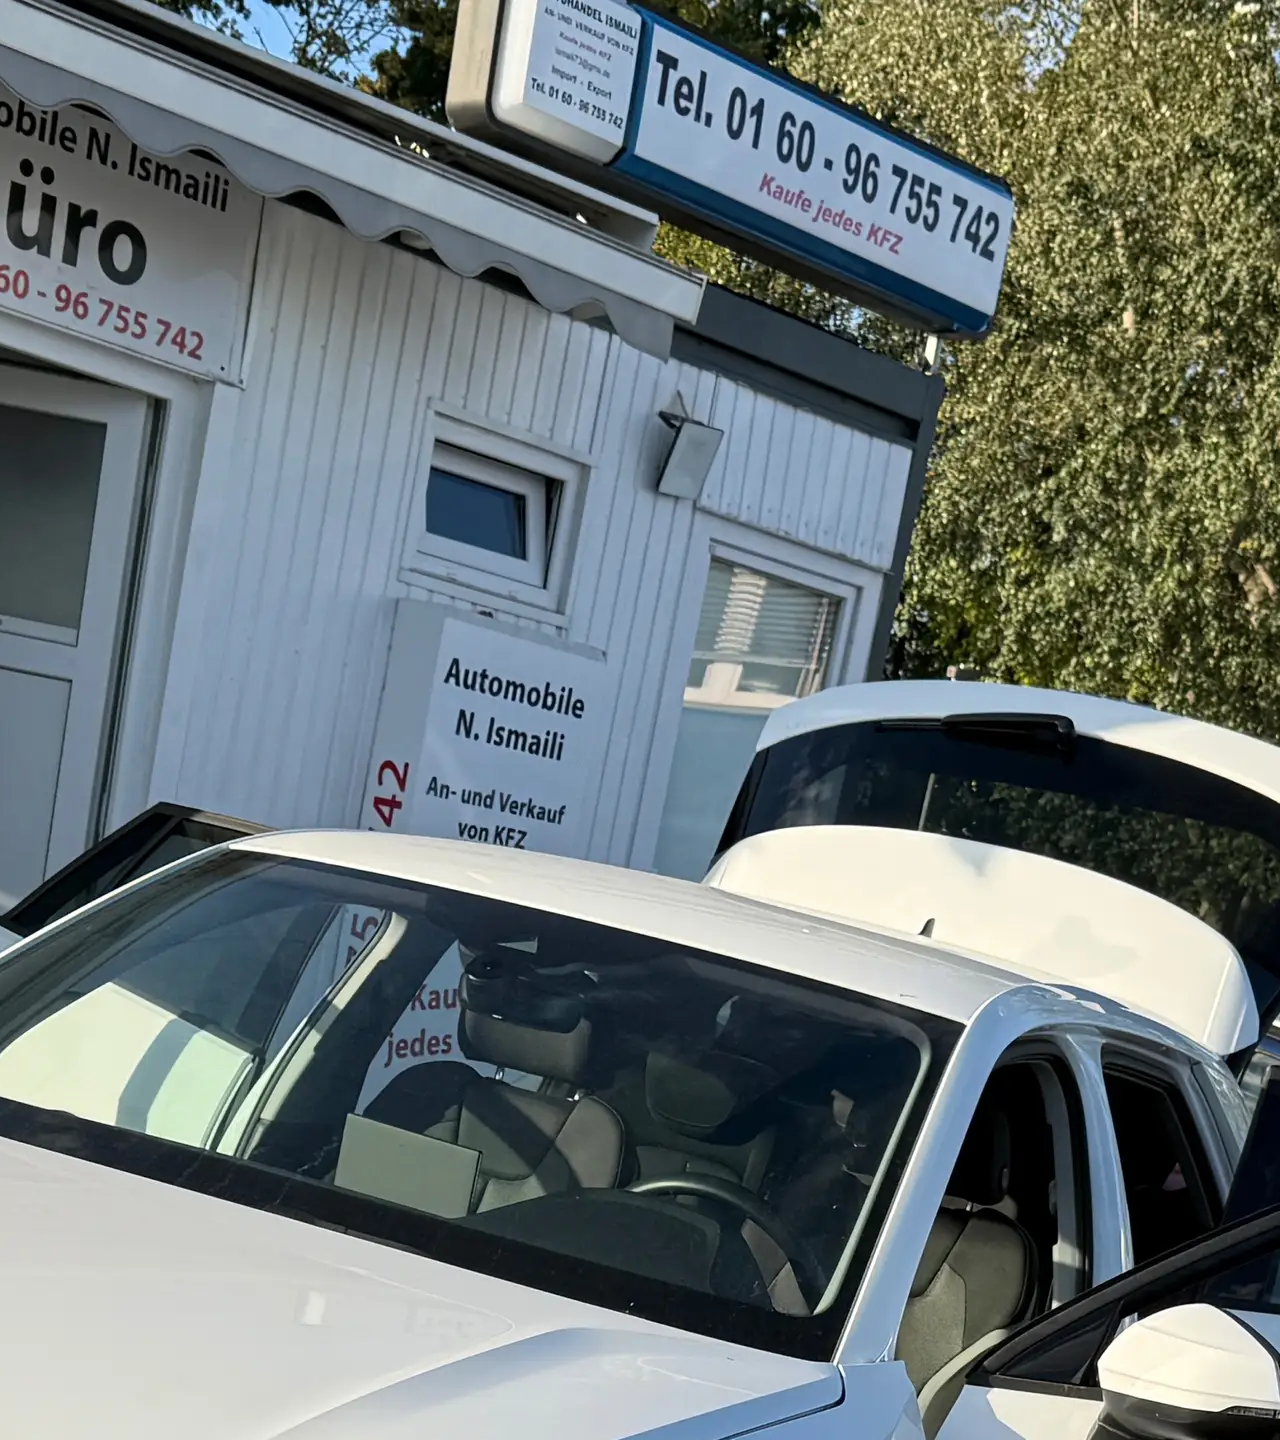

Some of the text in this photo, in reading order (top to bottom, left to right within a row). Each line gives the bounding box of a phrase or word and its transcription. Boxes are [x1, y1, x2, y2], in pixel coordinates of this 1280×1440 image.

[605, 14, 637, 39] ISMAILI
[548, 85, 559, 100] 01
[561, 91, 573, 106] 60
[578, 99, 590, 114] 96
[591, 104, 607, 122] 755
[608, 112, 624, 130] 742
[551, 64, 577, 84] Import
[587, 81, 612, 100] Export
[85, 126, 119, 171] N.
[127, 142, 230, 213] Ismaili
[656, 49, 1000, 262] Tel. 01 60 - 96 755 742
[758, 173, 904, 255] Kaufe jedes KFZ
[36, 288, 48, 299] -
[54, 283, 90, 320] 96
[97, 297, 148, 341] 755
[154, 318, 204, 361] 742
[443, 657, 585, 719] Automobile
[455, 708, 566, 761] N. Ismaili
[372, 759, 409, 829] 42
[425, 776, 567, 825] An- und Verkauf
[457, 821, 528, 849] von KFZ
[383, 1028, 453, 1069] jedes
